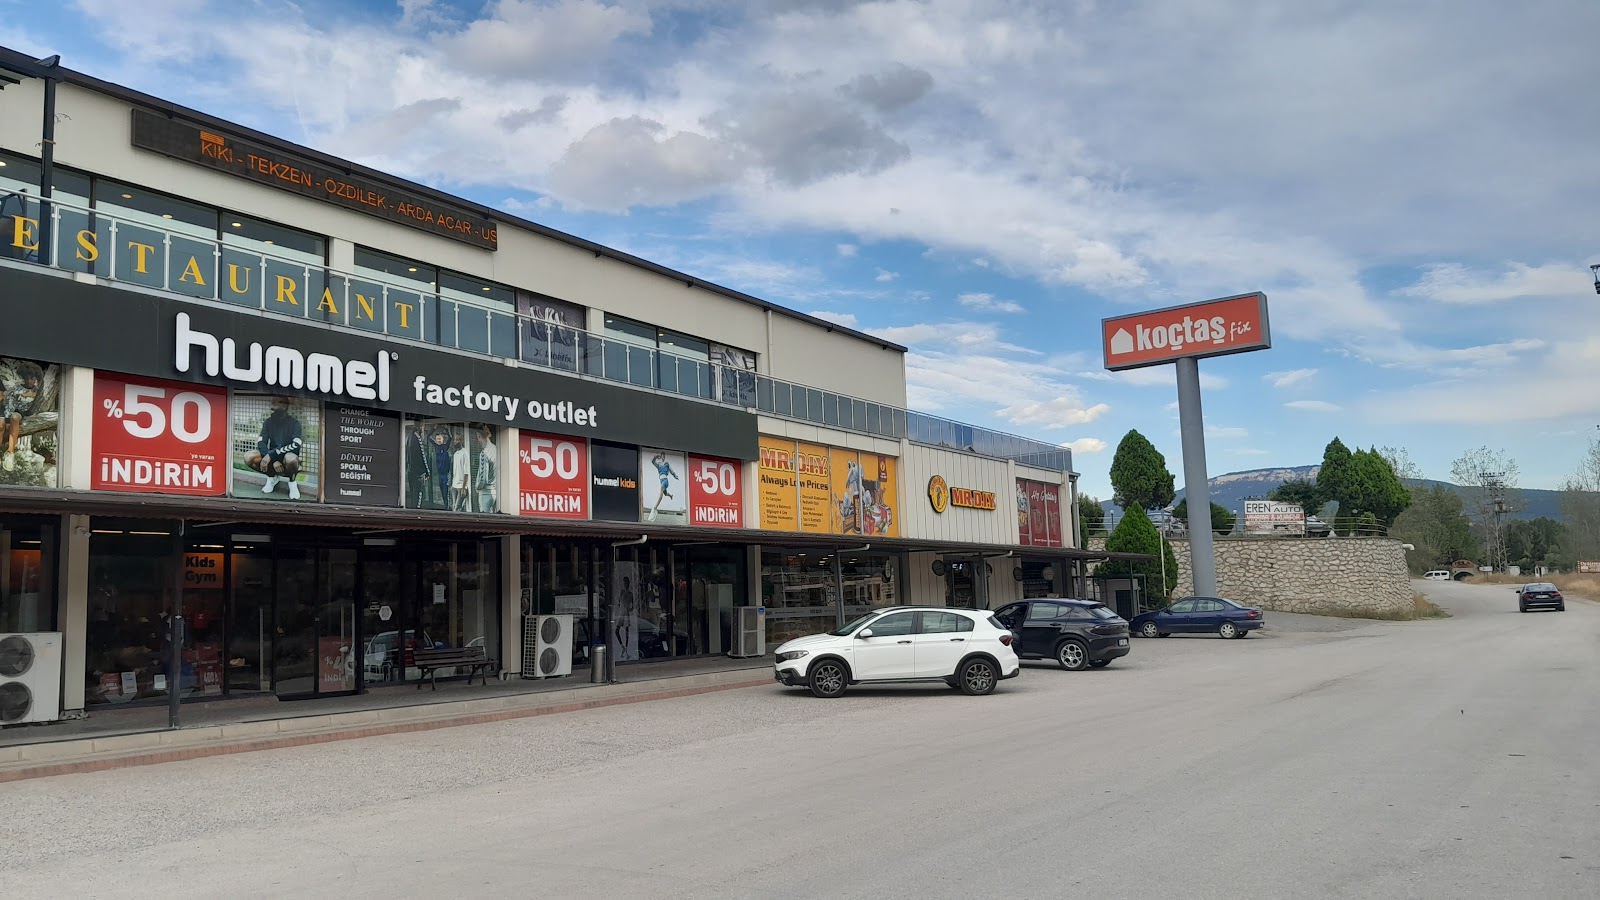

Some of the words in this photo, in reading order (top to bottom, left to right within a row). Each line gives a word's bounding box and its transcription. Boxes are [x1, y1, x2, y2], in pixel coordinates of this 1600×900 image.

[248, 154, 312, 187] TEKZEN
[397, 202, 434, 224] ARDA
[437, 214, 472, 235] ACAR
[1136, 316, 1226, 351] koçtaş
[1229, 320, 1251, 342] fix
[413, 376, 519, 421] factory
[527, 400, 597, 428] outlet
[103, 384, 212, 443] %50
[340, 407, 370, 417] CHANGE
[340, 416, 355, 425] THE
[357, 418, 384, 428] WORLD
[340, 426, 375, 435] THROUGH
[340, 435, 363, 444] SPORT
[520, 438, 579, 480] %50
[340, 463, 367, 471] SPORLA
[694, 461, 736, 496] %50
[761, 474, 788, 488] Always
[806, 479, 829, 491] Prices
[1246, 502, 1271, 514] EREN
[185, 556, 216, 569] Kids
[185, 570, 217, 585] Gym
